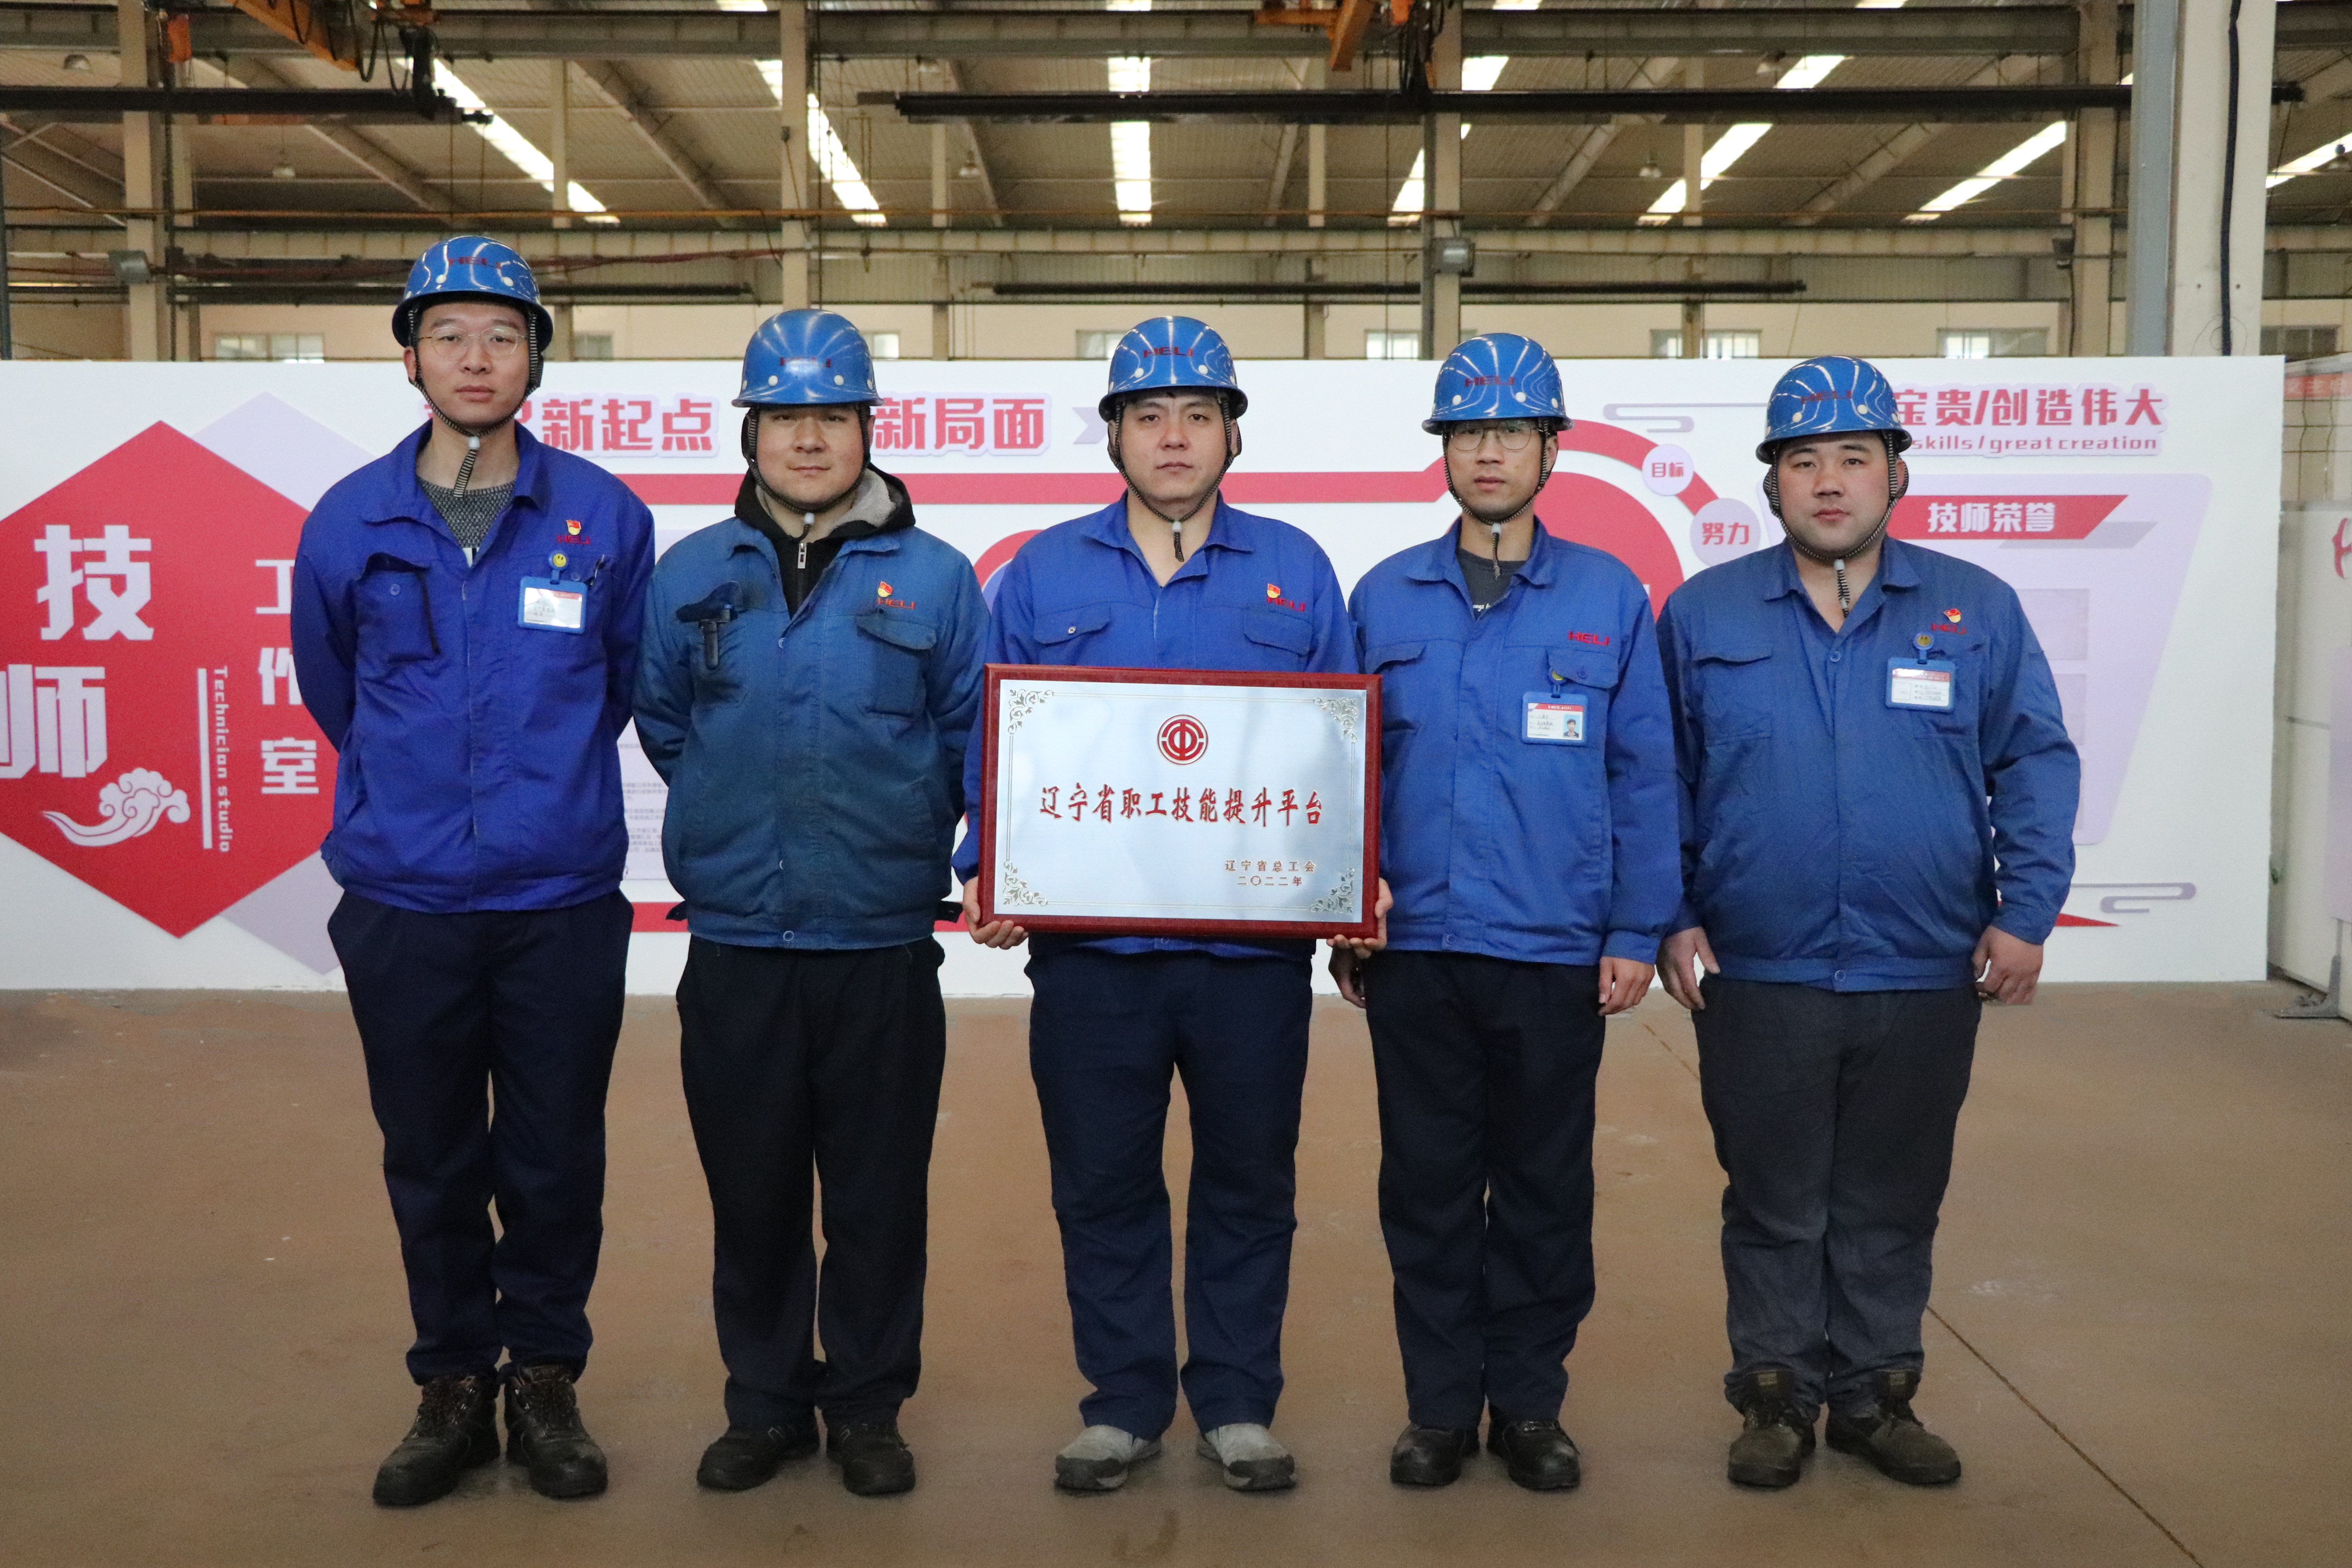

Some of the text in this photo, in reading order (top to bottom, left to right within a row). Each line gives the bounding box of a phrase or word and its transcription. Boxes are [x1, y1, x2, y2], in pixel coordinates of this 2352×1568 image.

[1143, 346, 1194, 358] HELI
[874, 397, 1044, 450] 新局面
[1651, 462, 1684, 477] 目标
[1927, 502, 2056, 532] 技师荣誉
[1702, 522, 1750, 545] 努力
[1568, 631, 1610, 646] HELI
[214, 666, 233, 852] Technician studio
[1039, 782, 1322, 827] 辽宁省职工技能提升平台
[1225, 860, 1316, 872] 辽宁省总工会
